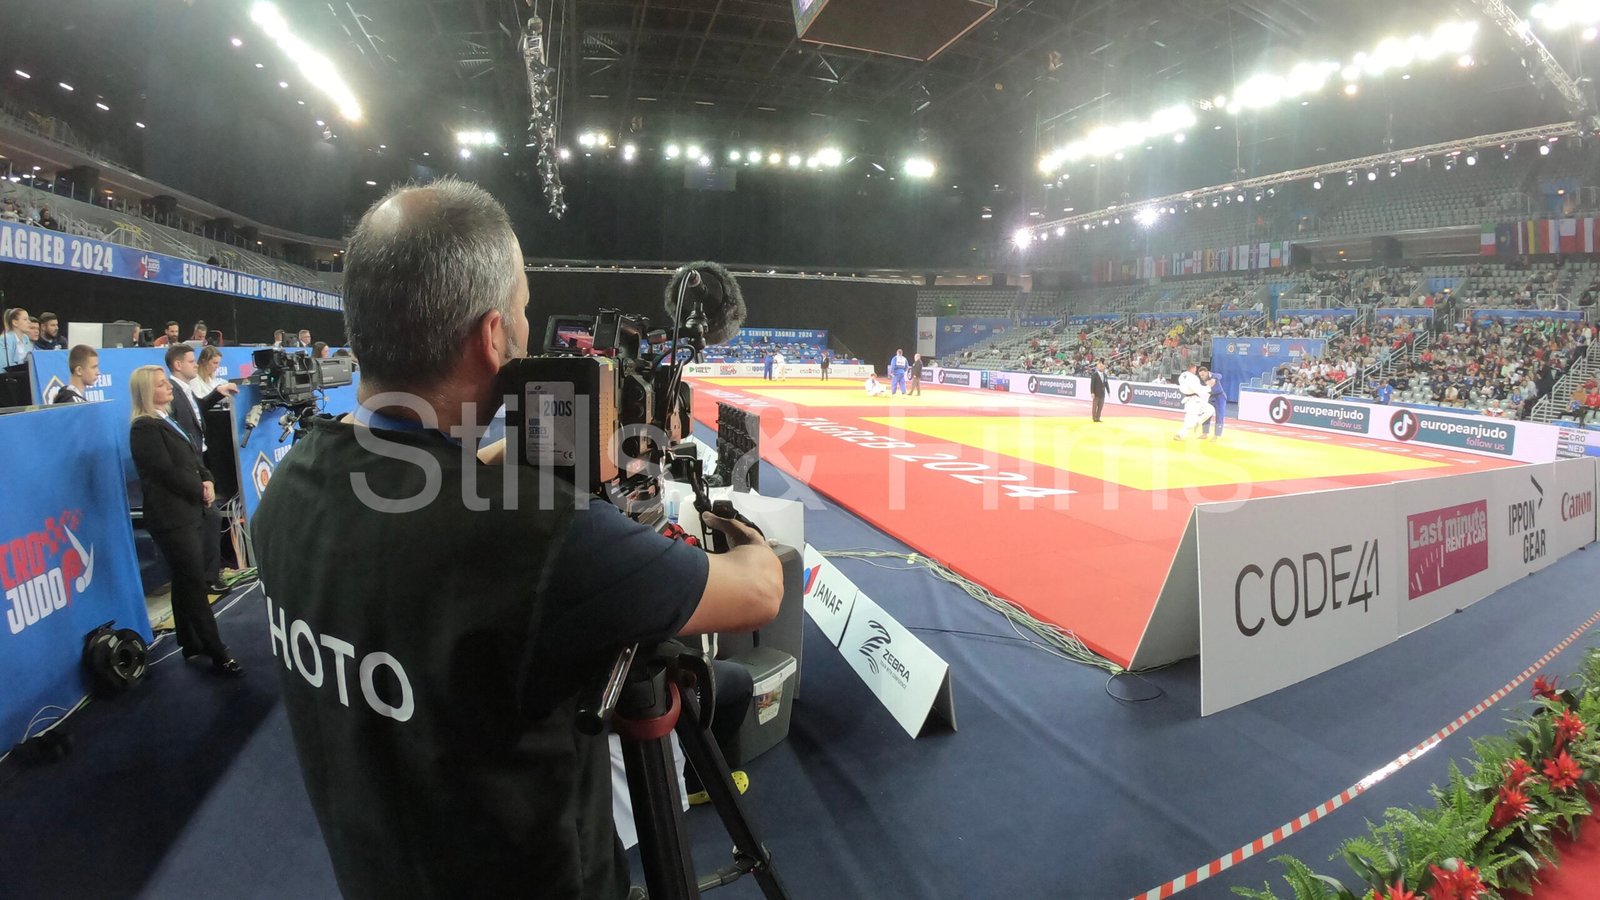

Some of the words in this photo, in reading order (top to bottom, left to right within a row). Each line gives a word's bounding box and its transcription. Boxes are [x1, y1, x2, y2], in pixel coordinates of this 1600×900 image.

[71, 240, 113, 273] 2024
[183, 263, 235, 293] EUROPEAN
[237, 275, 259, 296] JUDO
[261, 280, 316, 306] CHAMPIONSHIPS
[1039, 379, 1074, 391] europeanjudo
[1133, 388, 1182, 401] europeanjudo
[544, 400, 572, 416] 200S
[1293, 405, 1364, 422] europeanjudo
[1330, 418, 1351, 429] follow
[1352, 422, 1362, 430] us
[1420, 419, 1508, 441] europeanjudo
[1466, 437, 1492, 450] follow
[1494, 441, 1505, 450] us
[1569, 434, 1586, 443] CRO
[784, 416, 916, 449] ZAGREB
[892, 453, 1078, 498] 2024
[1568, 443, 1585, 454] NED
[1508, 499, 1535, 536] IPPON
[1561, 490, 1592, 522] Canon
[1409, 515, 1443, 550] Last
[1445, 507, 1486, 540] minute
[1446, 534, 1465, 553] RENT
[1466, 532, 1472, 547] A
[1472, 527, 1487, 545] CAR
[1523, 528, 1546, 564] GEAR
[6, 567, 67, 635] JUDO
[813, 580, 843, 615] JANAF
[261, 581, 415, 722] HOTO
[883, 648, 910, 682] ZEBRA
